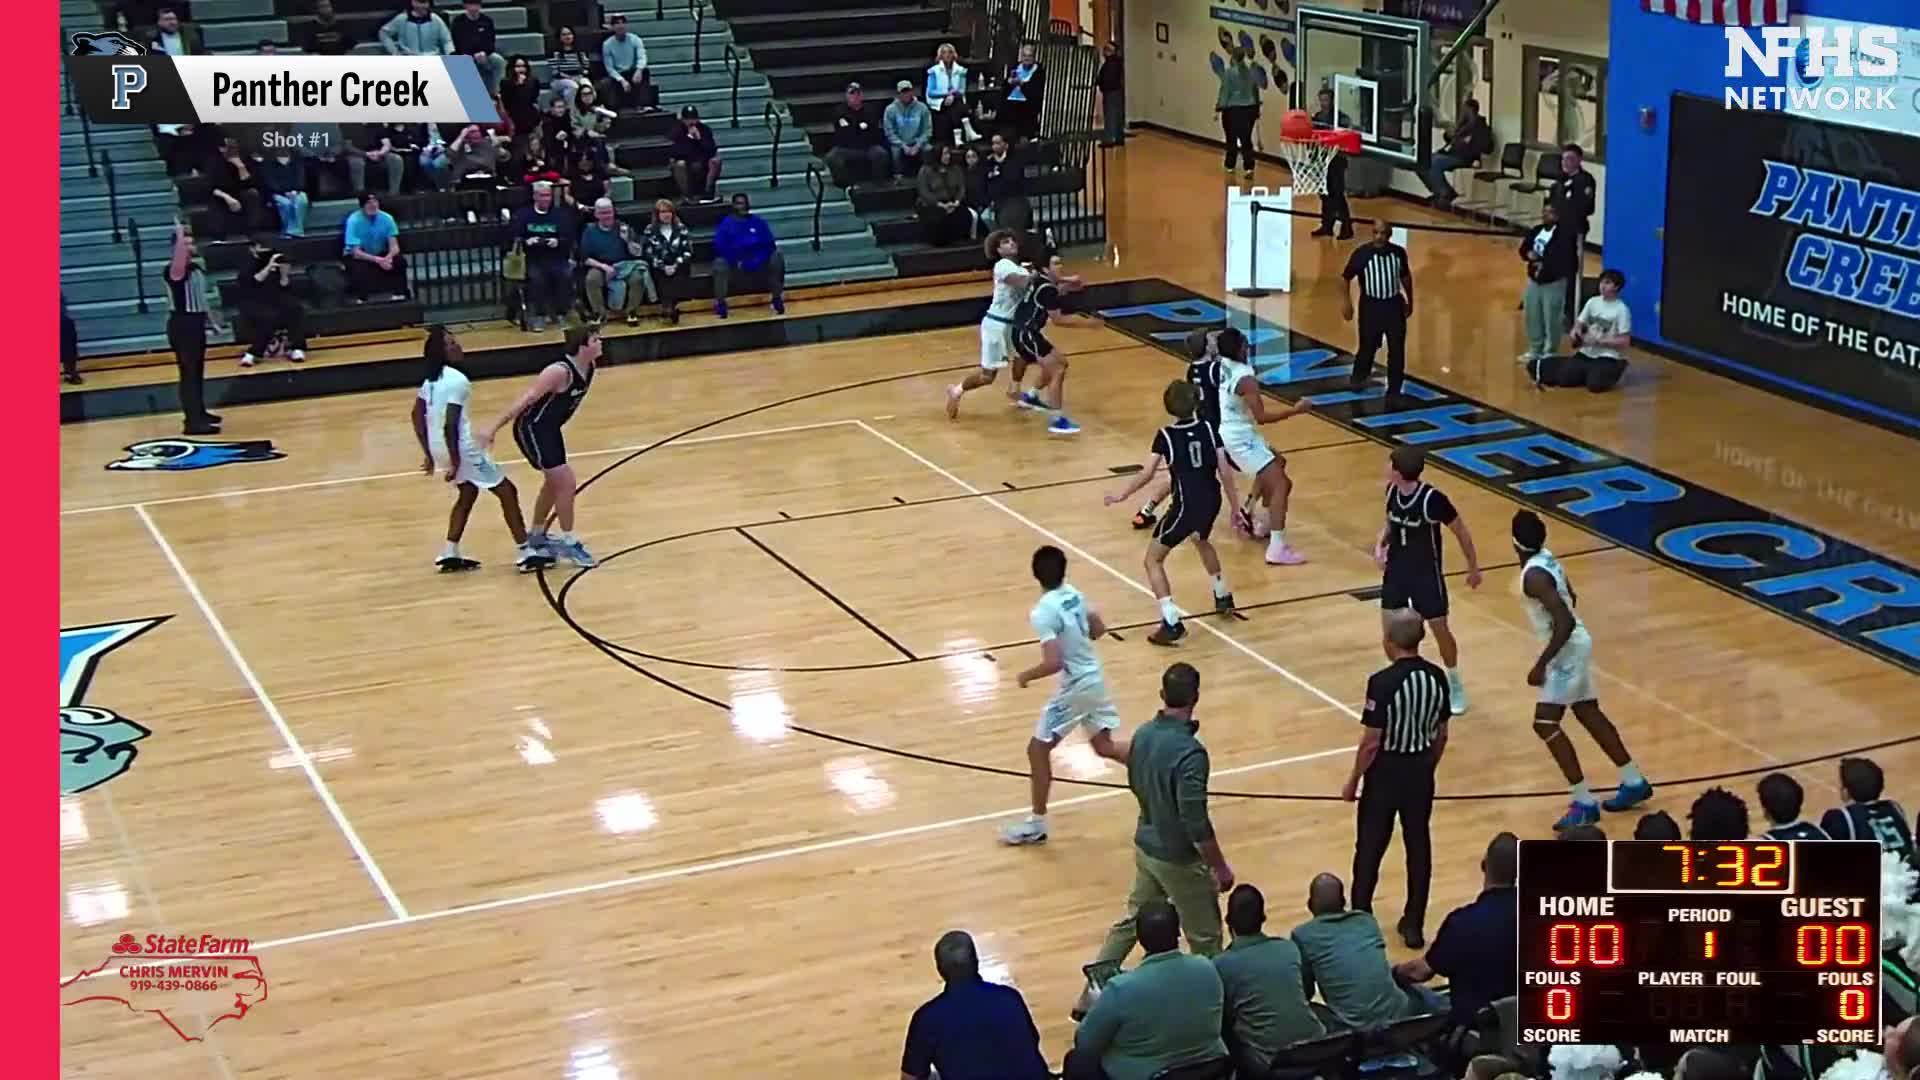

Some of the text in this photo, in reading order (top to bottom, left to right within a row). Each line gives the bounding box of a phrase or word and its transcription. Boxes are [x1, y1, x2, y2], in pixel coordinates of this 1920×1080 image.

[1722, 292, 1920, 369] HOME OF THE CAT
[1188, 440, 1204, 468] 0
